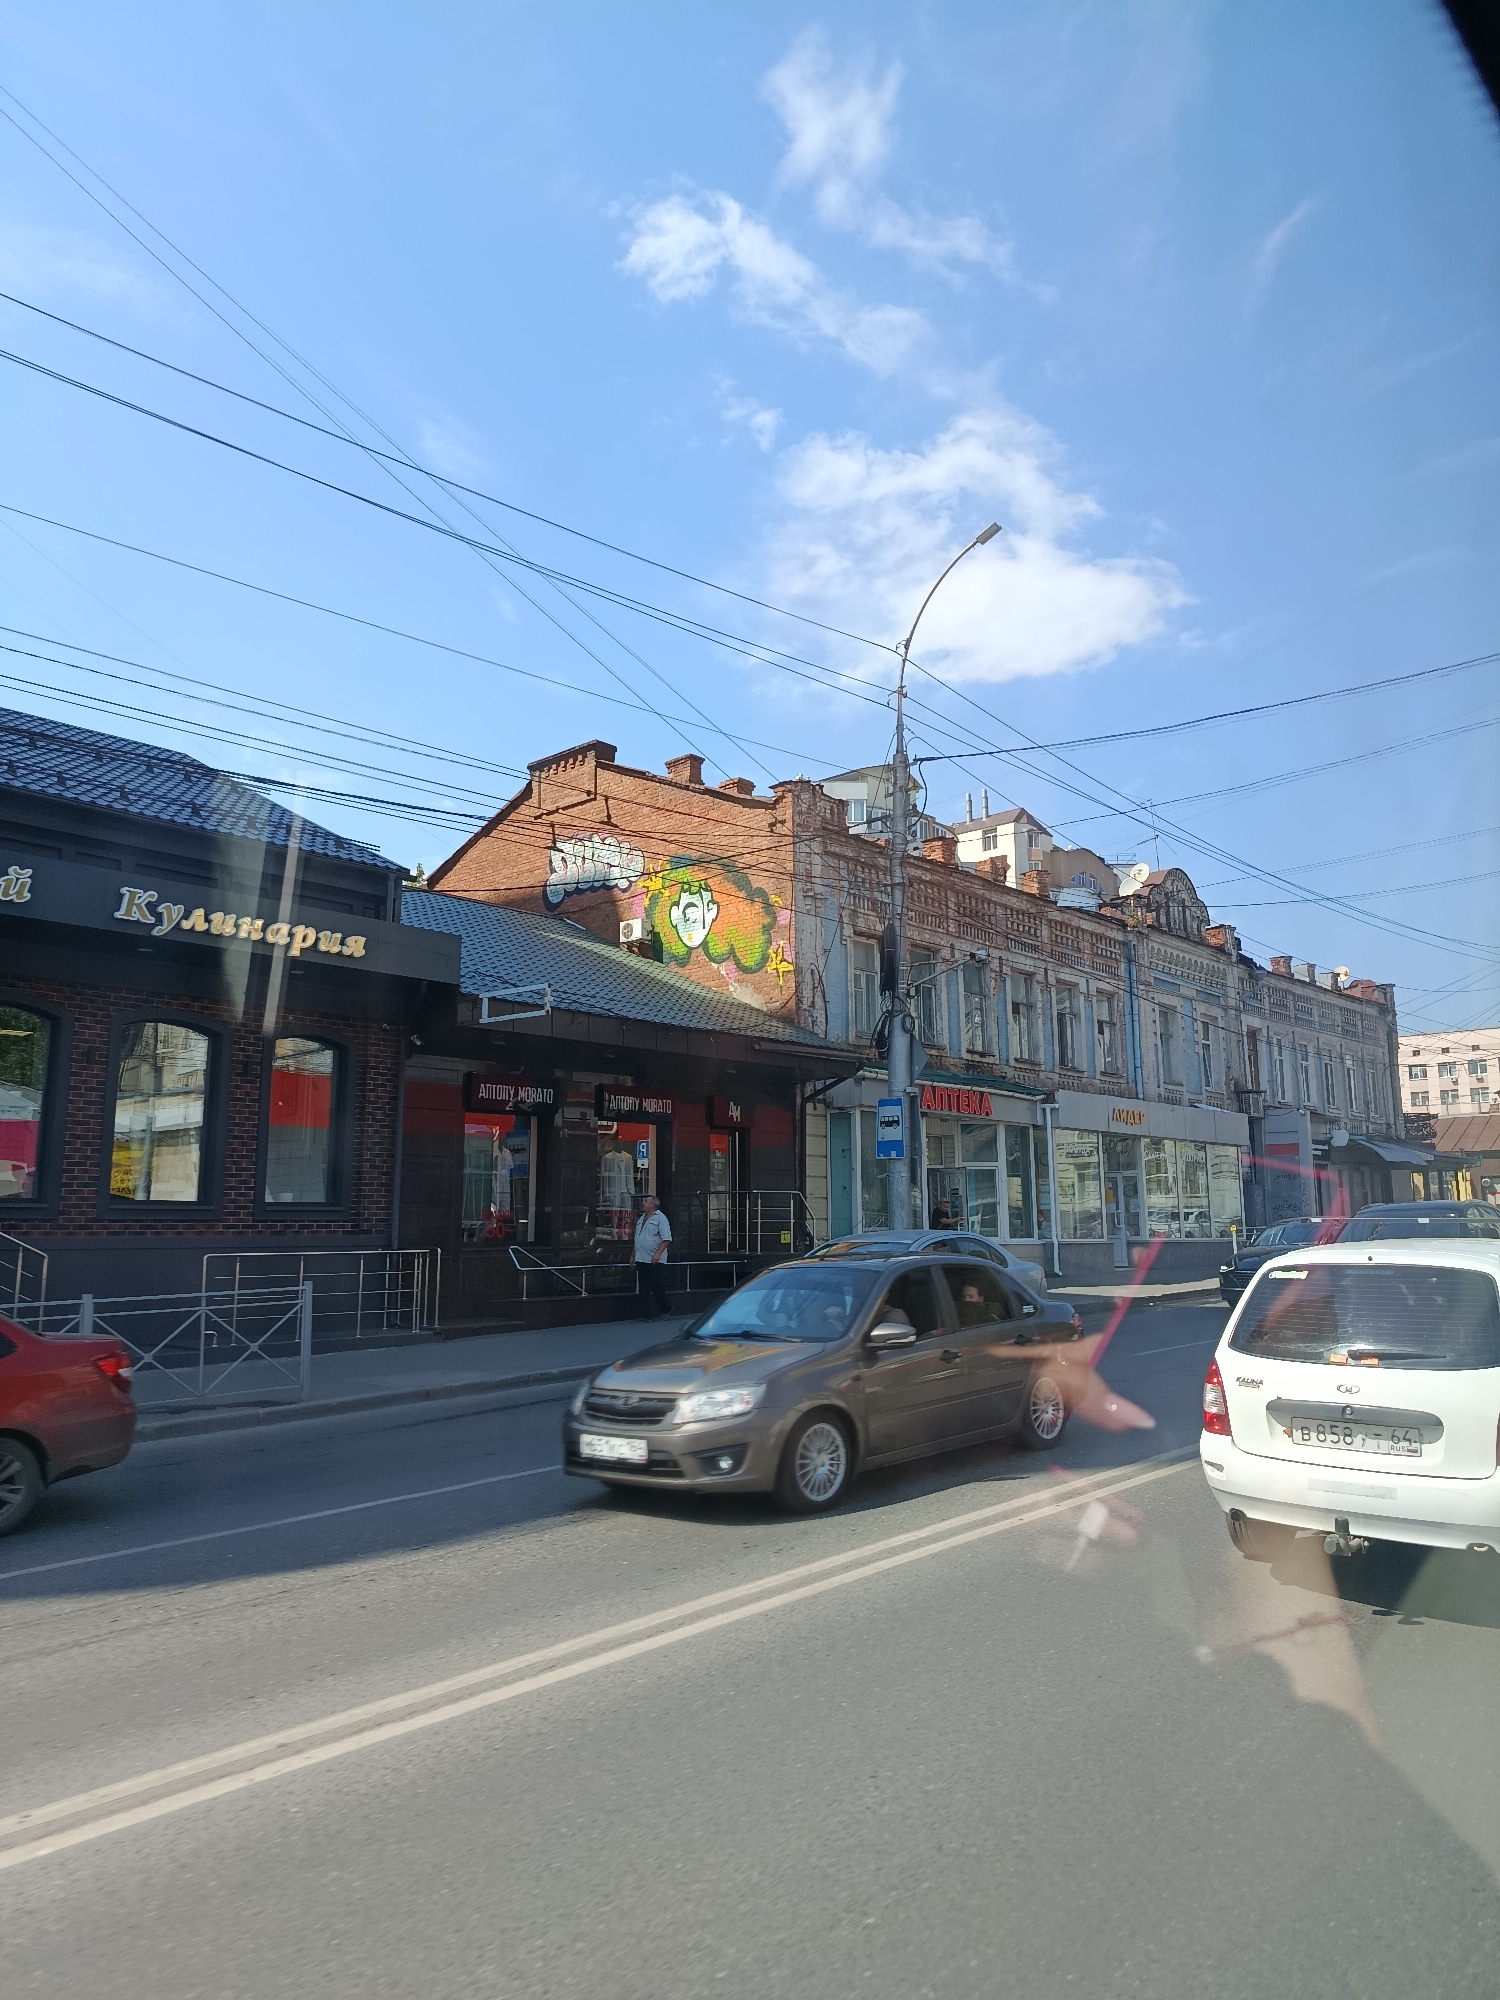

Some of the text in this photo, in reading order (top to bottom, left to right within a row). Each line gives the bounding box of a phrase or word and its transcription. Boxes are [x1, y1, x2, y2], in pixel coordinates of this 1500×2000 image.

[114, 887, 367, 957] Кулинария
[518, 1086, 553, 1104] MORATO
[921, 1084, 993, 1117] АПТЕКА
[642, 1097, 672, 1114] MORATO
[1112, 1107, 1147, 1126] ЛИДЕР
[1235, 1376, 1264, 1385] KALINA
[1391, 1428, 1413, 1446] 64
[1390, 1444, 1406, 1453] RUS
